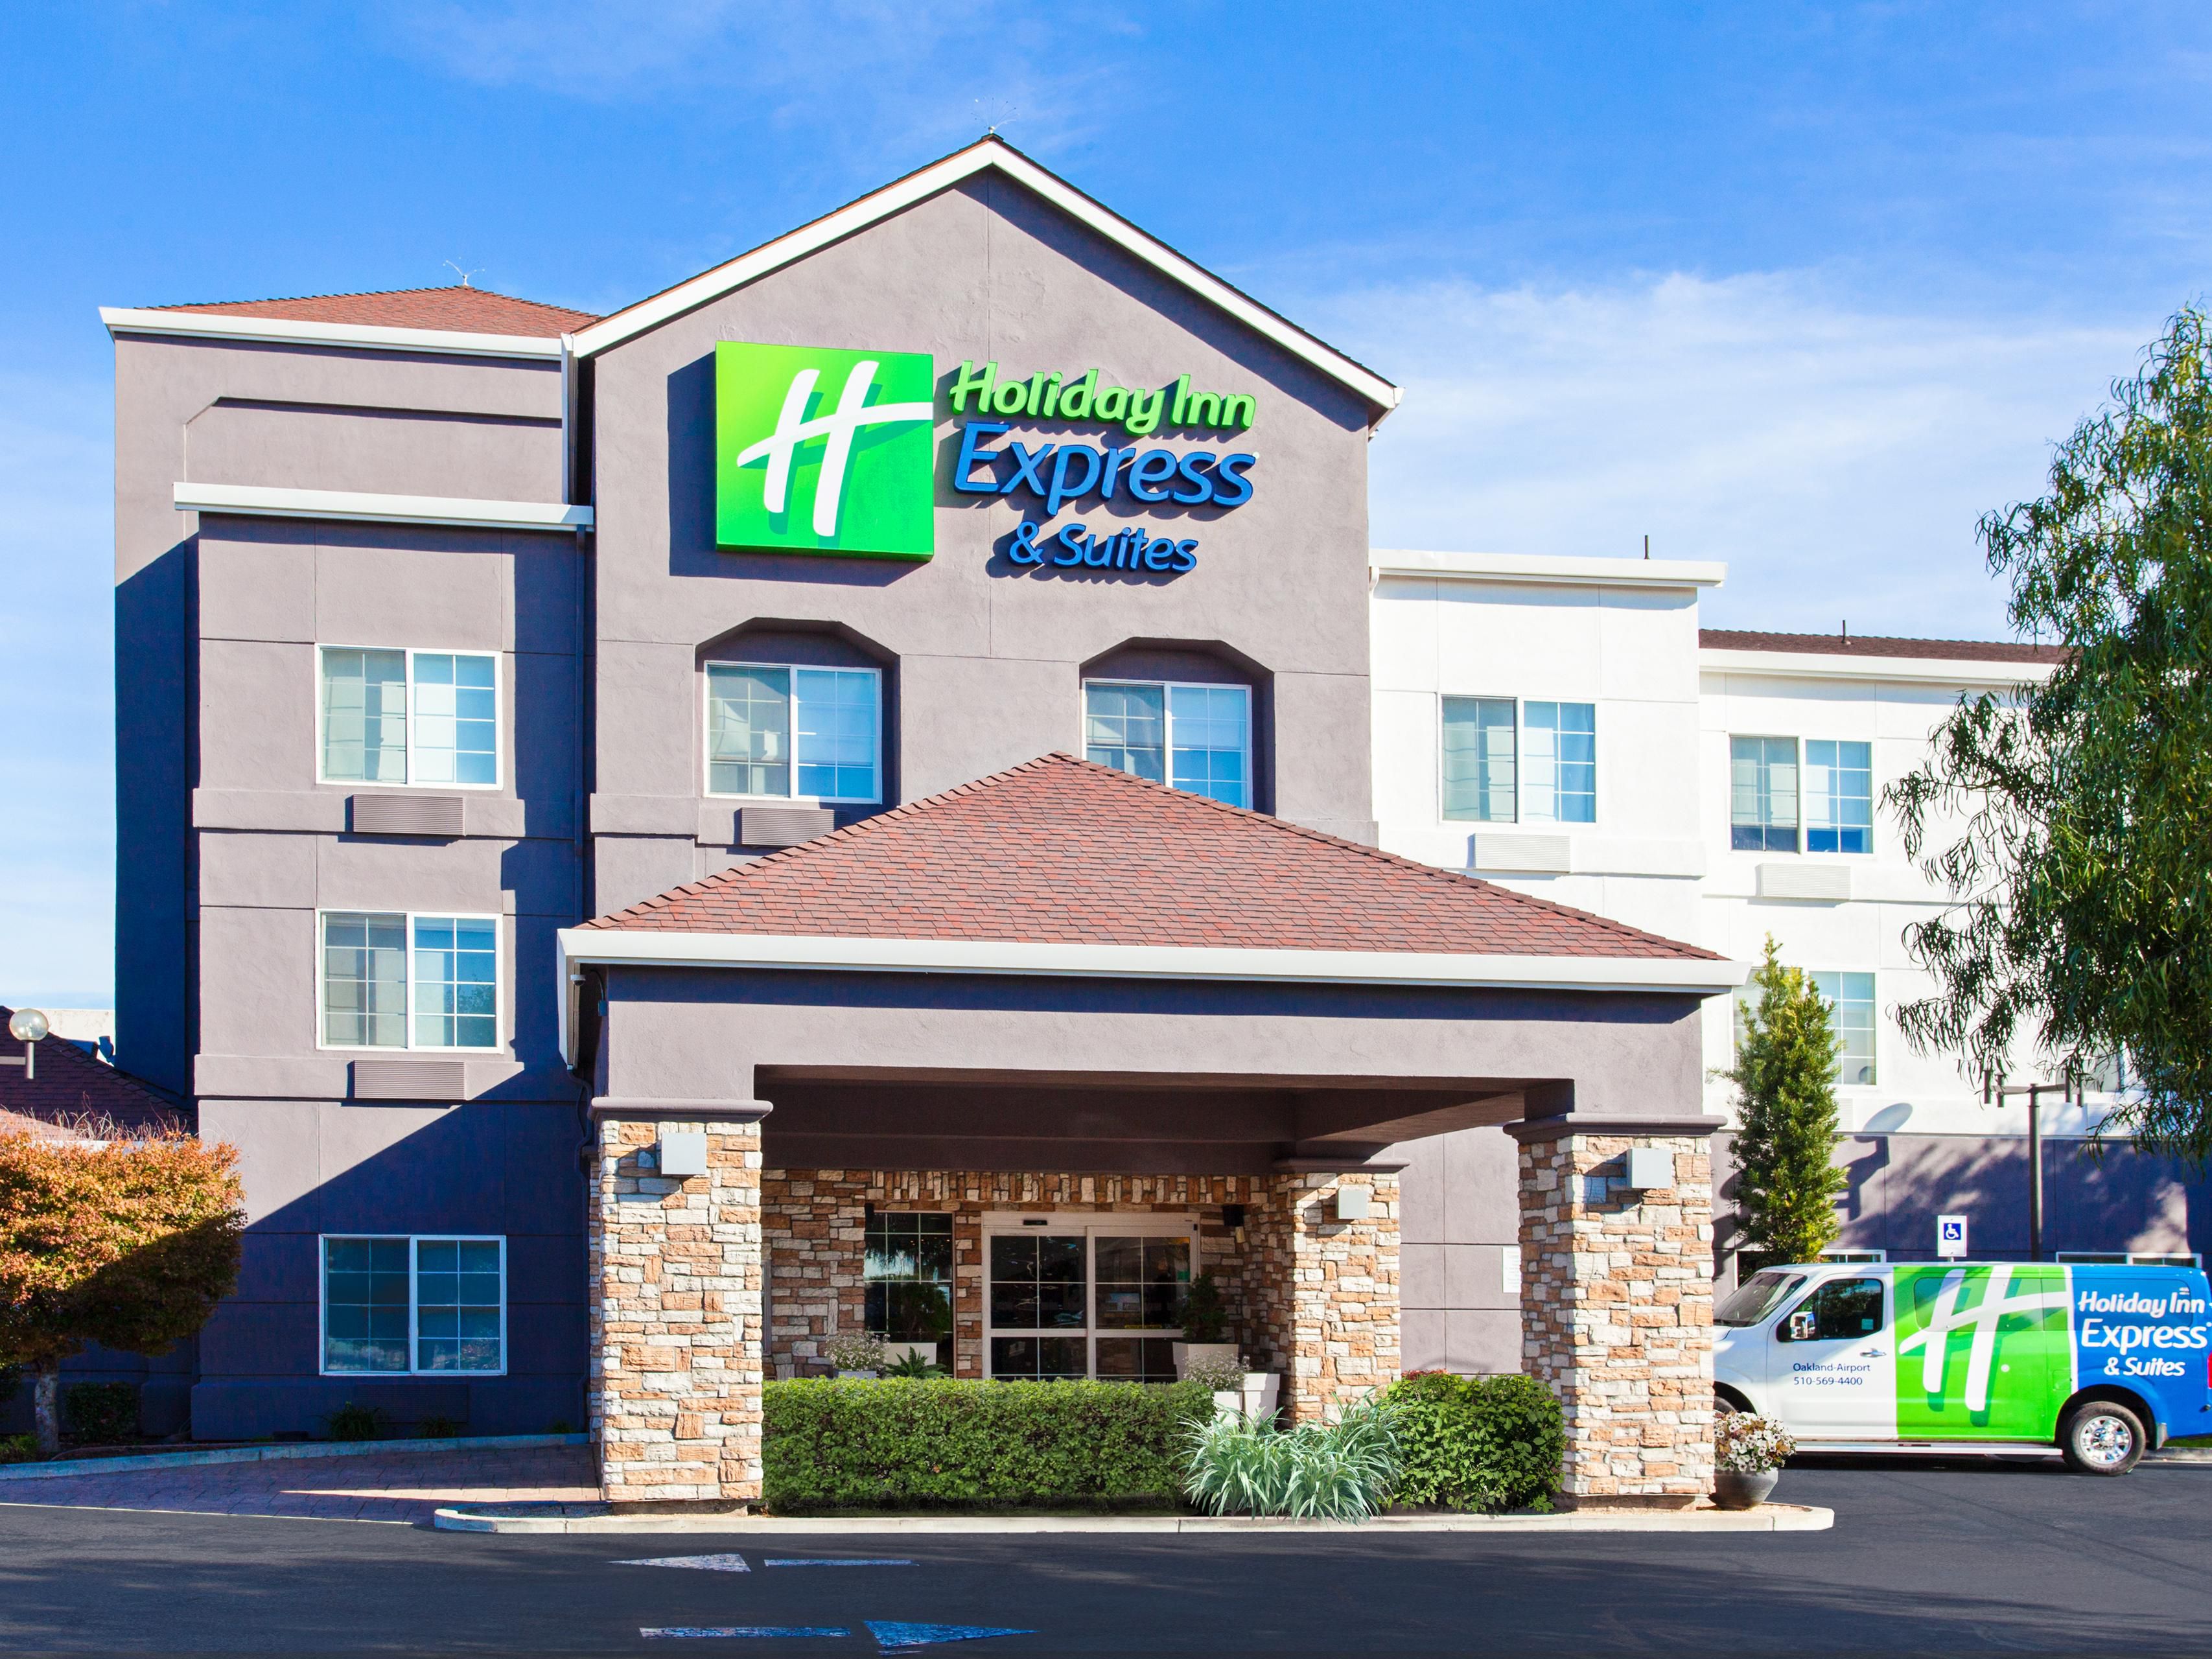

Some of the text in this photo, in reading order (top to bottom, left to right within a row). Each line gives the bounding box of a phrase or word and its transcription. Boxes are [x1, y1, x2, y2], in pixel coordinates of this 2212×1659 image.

[949, 360, 1255, 436] Holiday Inn
[954, 421, 1255, 516] Express
[1008, 521, 1198, 574] & Suites
[2077, 1291, 2206, 1318] Holiday Inn
[2081, 1318, 2207, 1355] Express
[1794, 1376, 1863, 1386] 510-569-4400
[2104, 1357, 2185, 1376] & Suites
